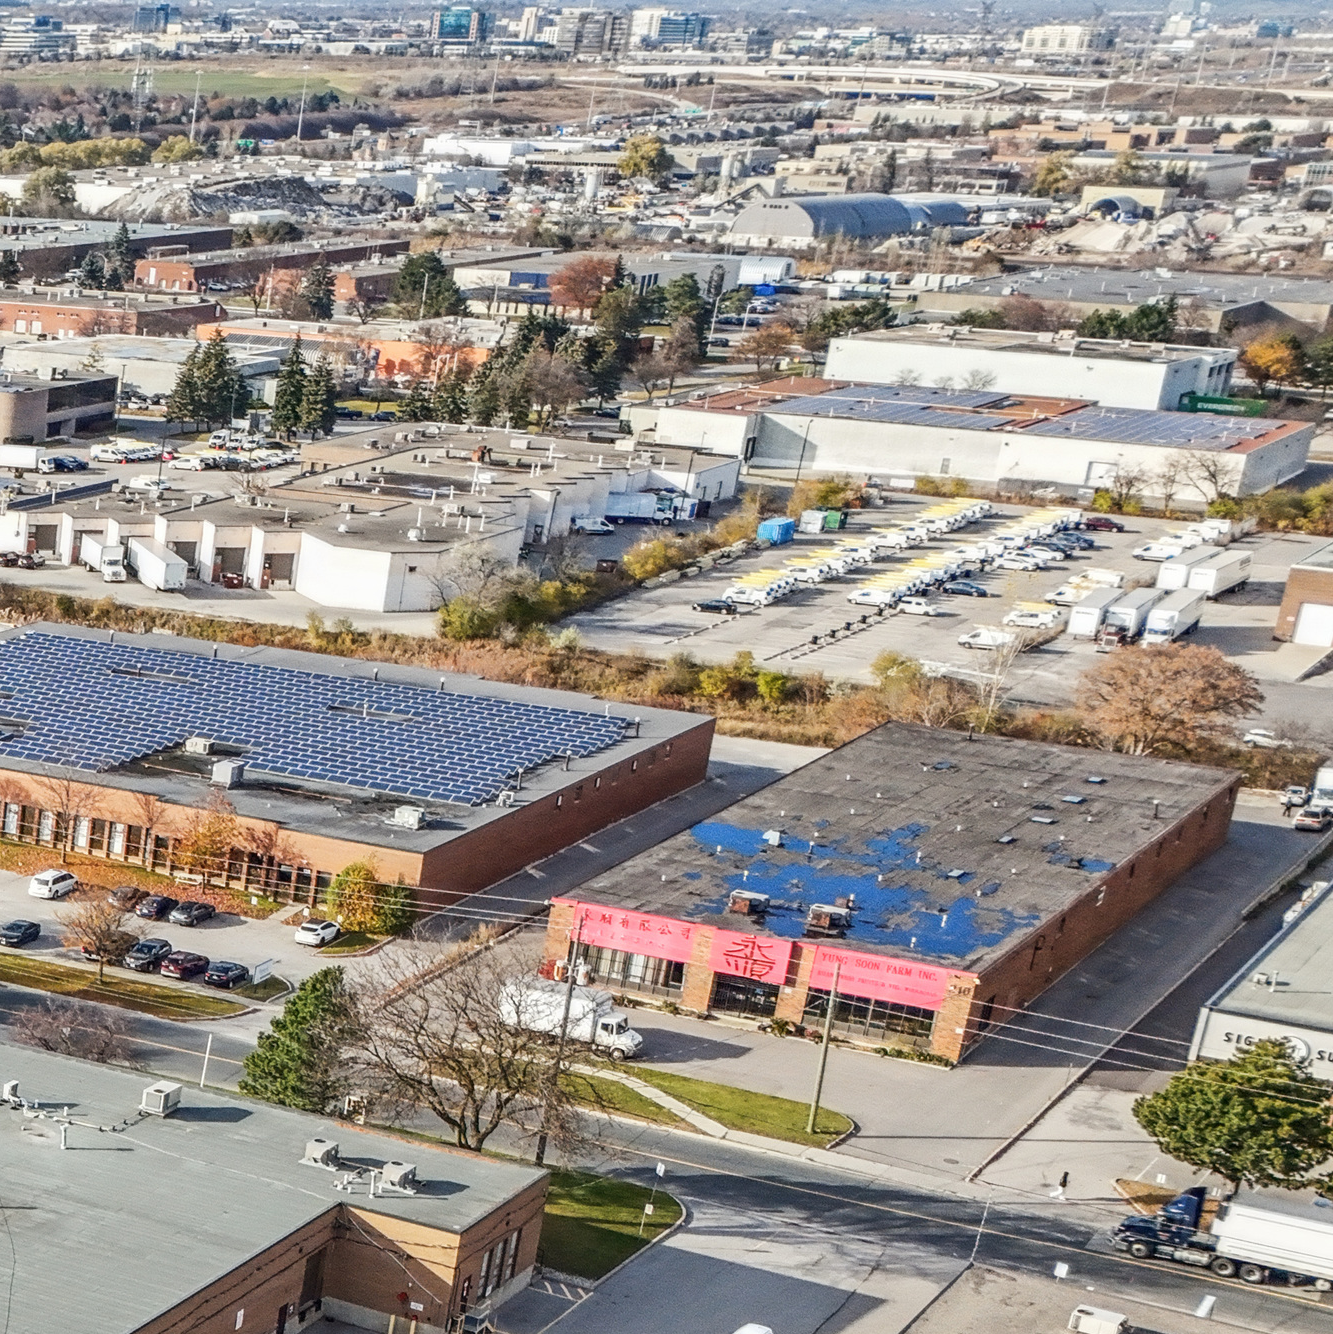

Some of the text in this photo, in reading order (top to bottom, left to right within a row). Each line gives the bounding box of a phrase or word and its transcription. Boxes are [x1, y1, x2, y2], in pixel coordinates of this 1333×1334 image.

[822, 952, 938, 982] YUNG SOON FARM INC.
